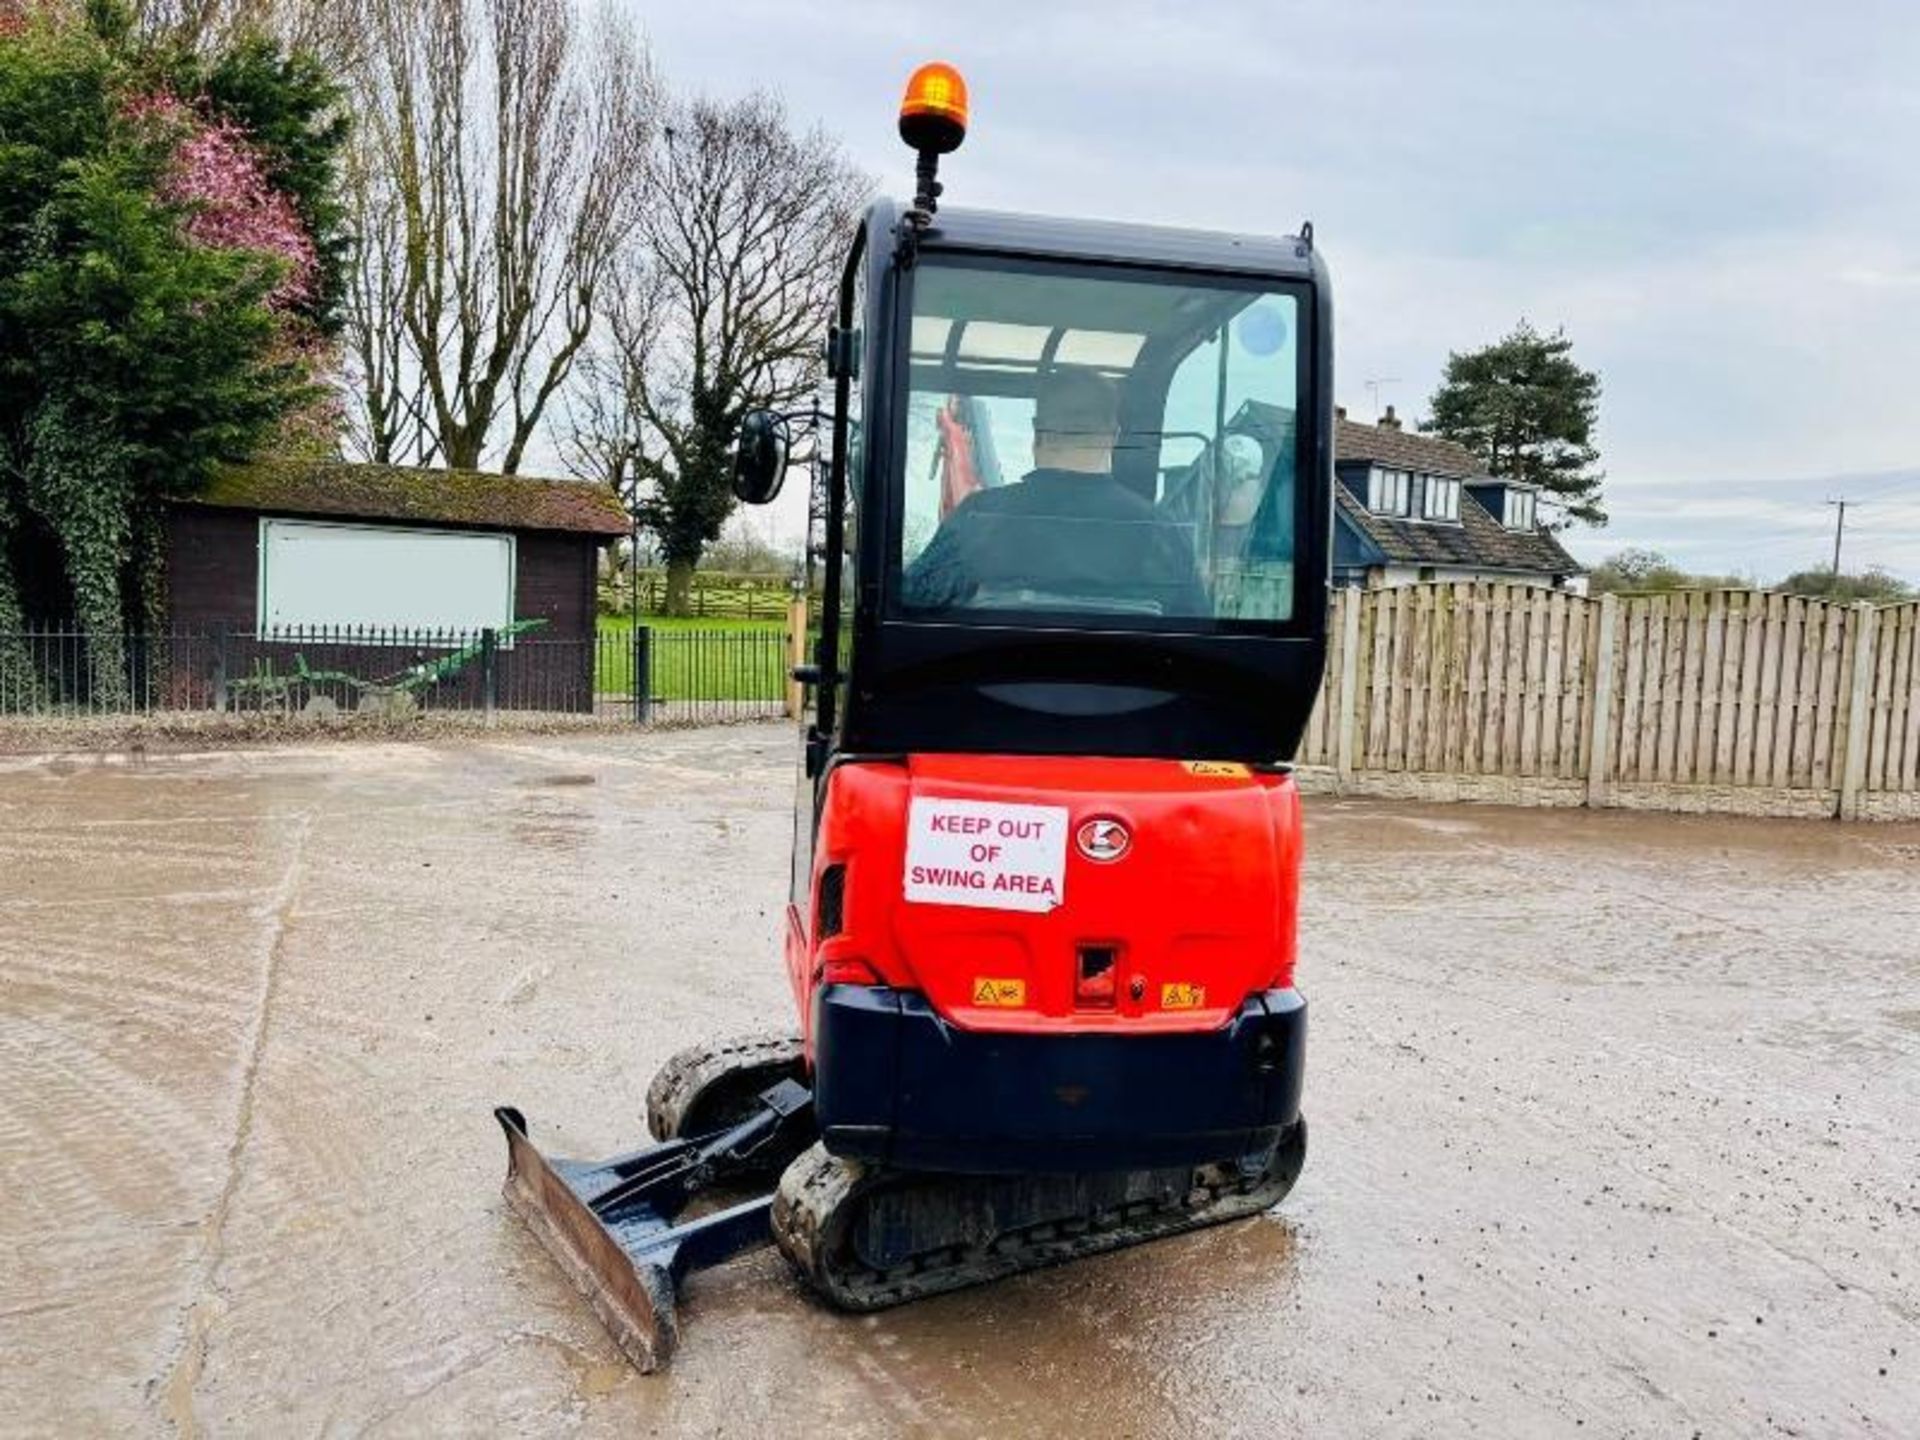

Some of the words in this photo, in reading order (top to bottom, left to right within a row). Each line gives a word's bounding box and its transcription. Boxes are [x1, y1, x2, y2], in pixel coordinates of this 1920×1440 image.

[931, 814, 991, 834] KEEP
[998, 820, 1046, 840] OUT
[971, 844, 1002, 863] OF
[911, 866, 985, 889] SWING
[993, 873, 1056, 895] AREA
